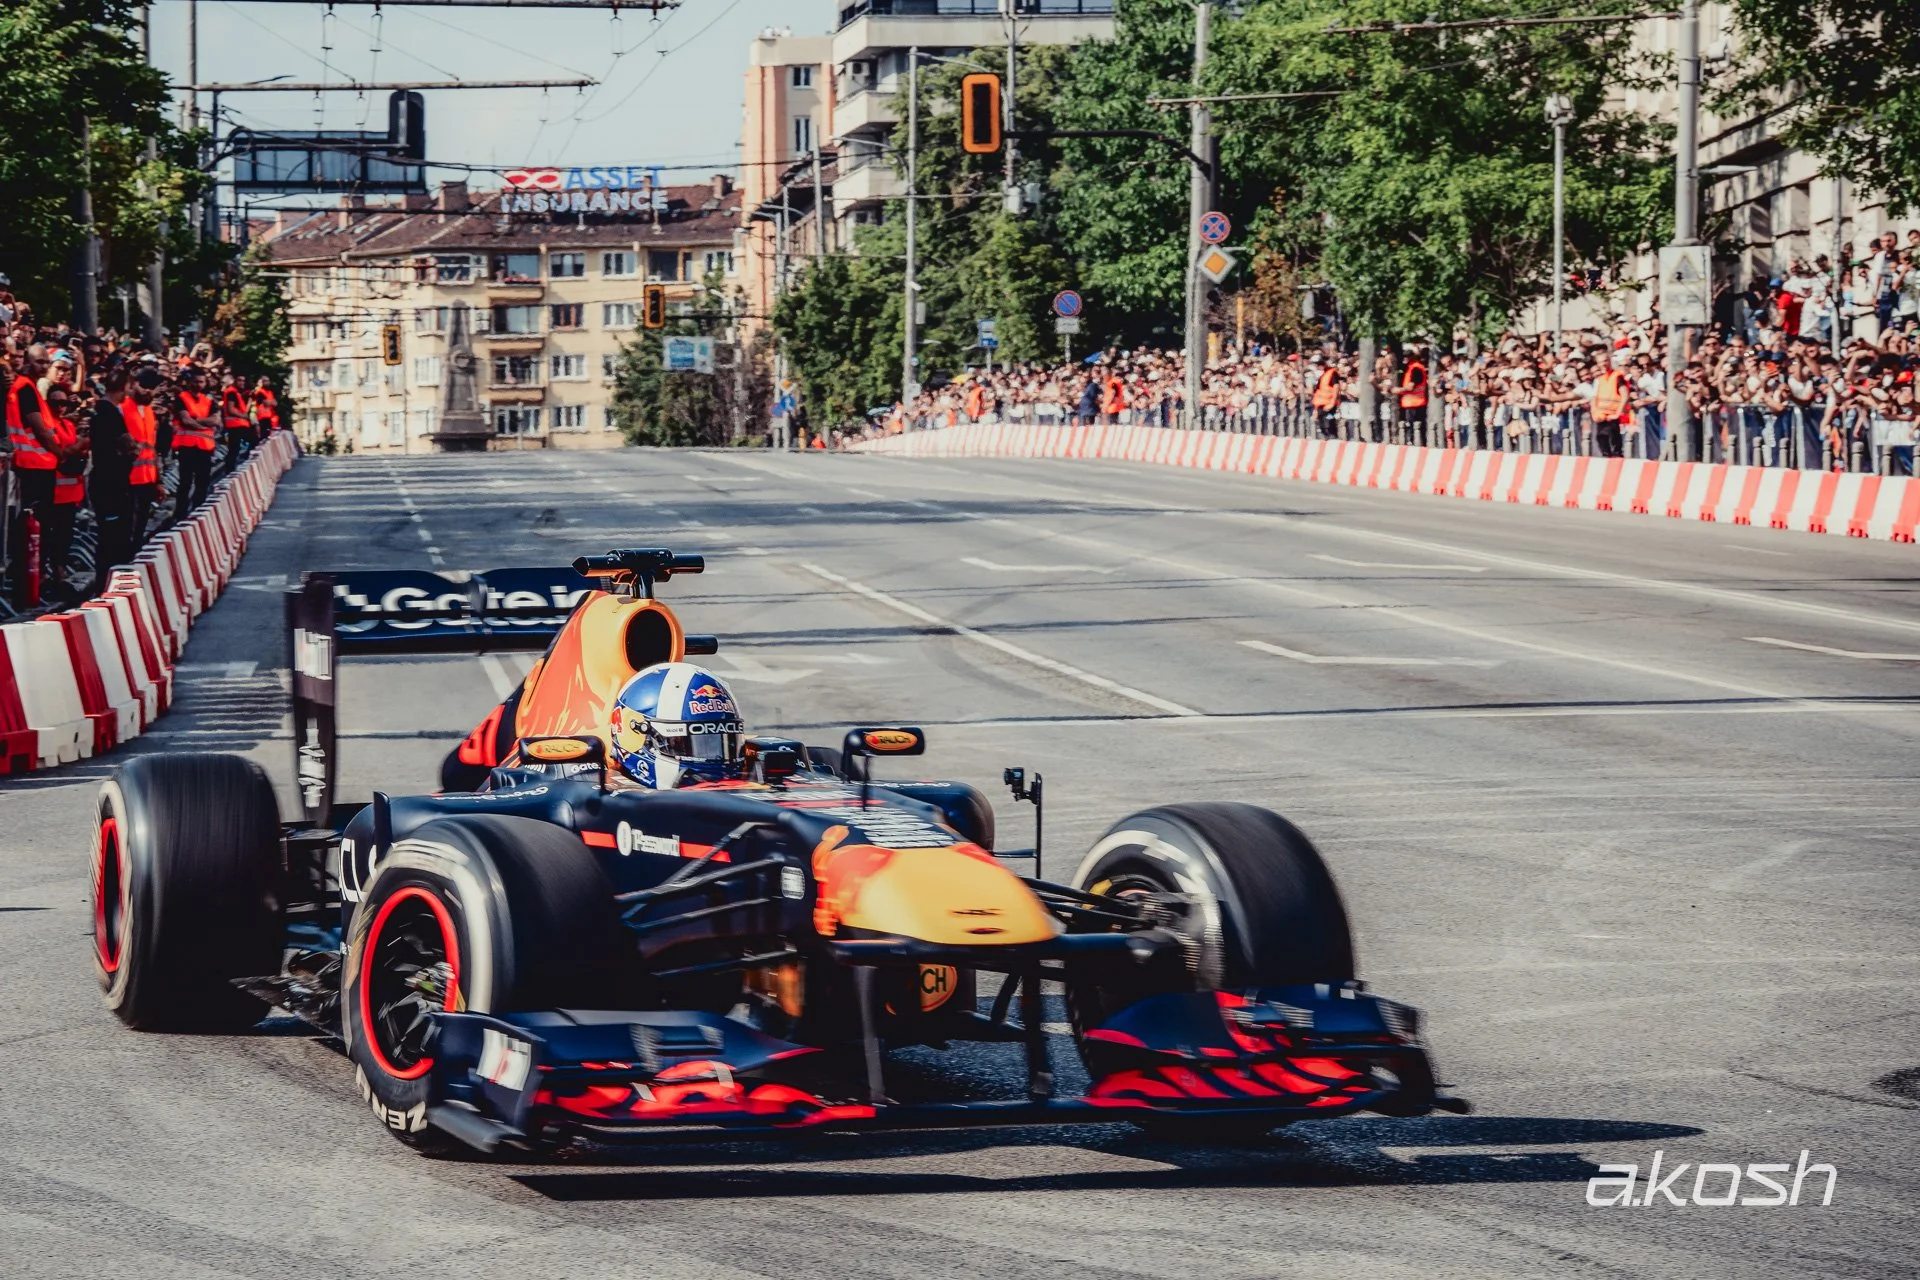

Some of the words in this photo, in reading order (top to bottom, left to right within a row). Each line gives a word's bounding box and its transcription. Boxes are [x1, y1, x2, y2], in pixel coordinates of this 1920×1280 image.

[565, 166, 665, 190] ASSET
[501, 190, 668, 213] INSURANCE
[690, 700, 714, 714] Red
[689, 723, 744, 735] ORACLE
